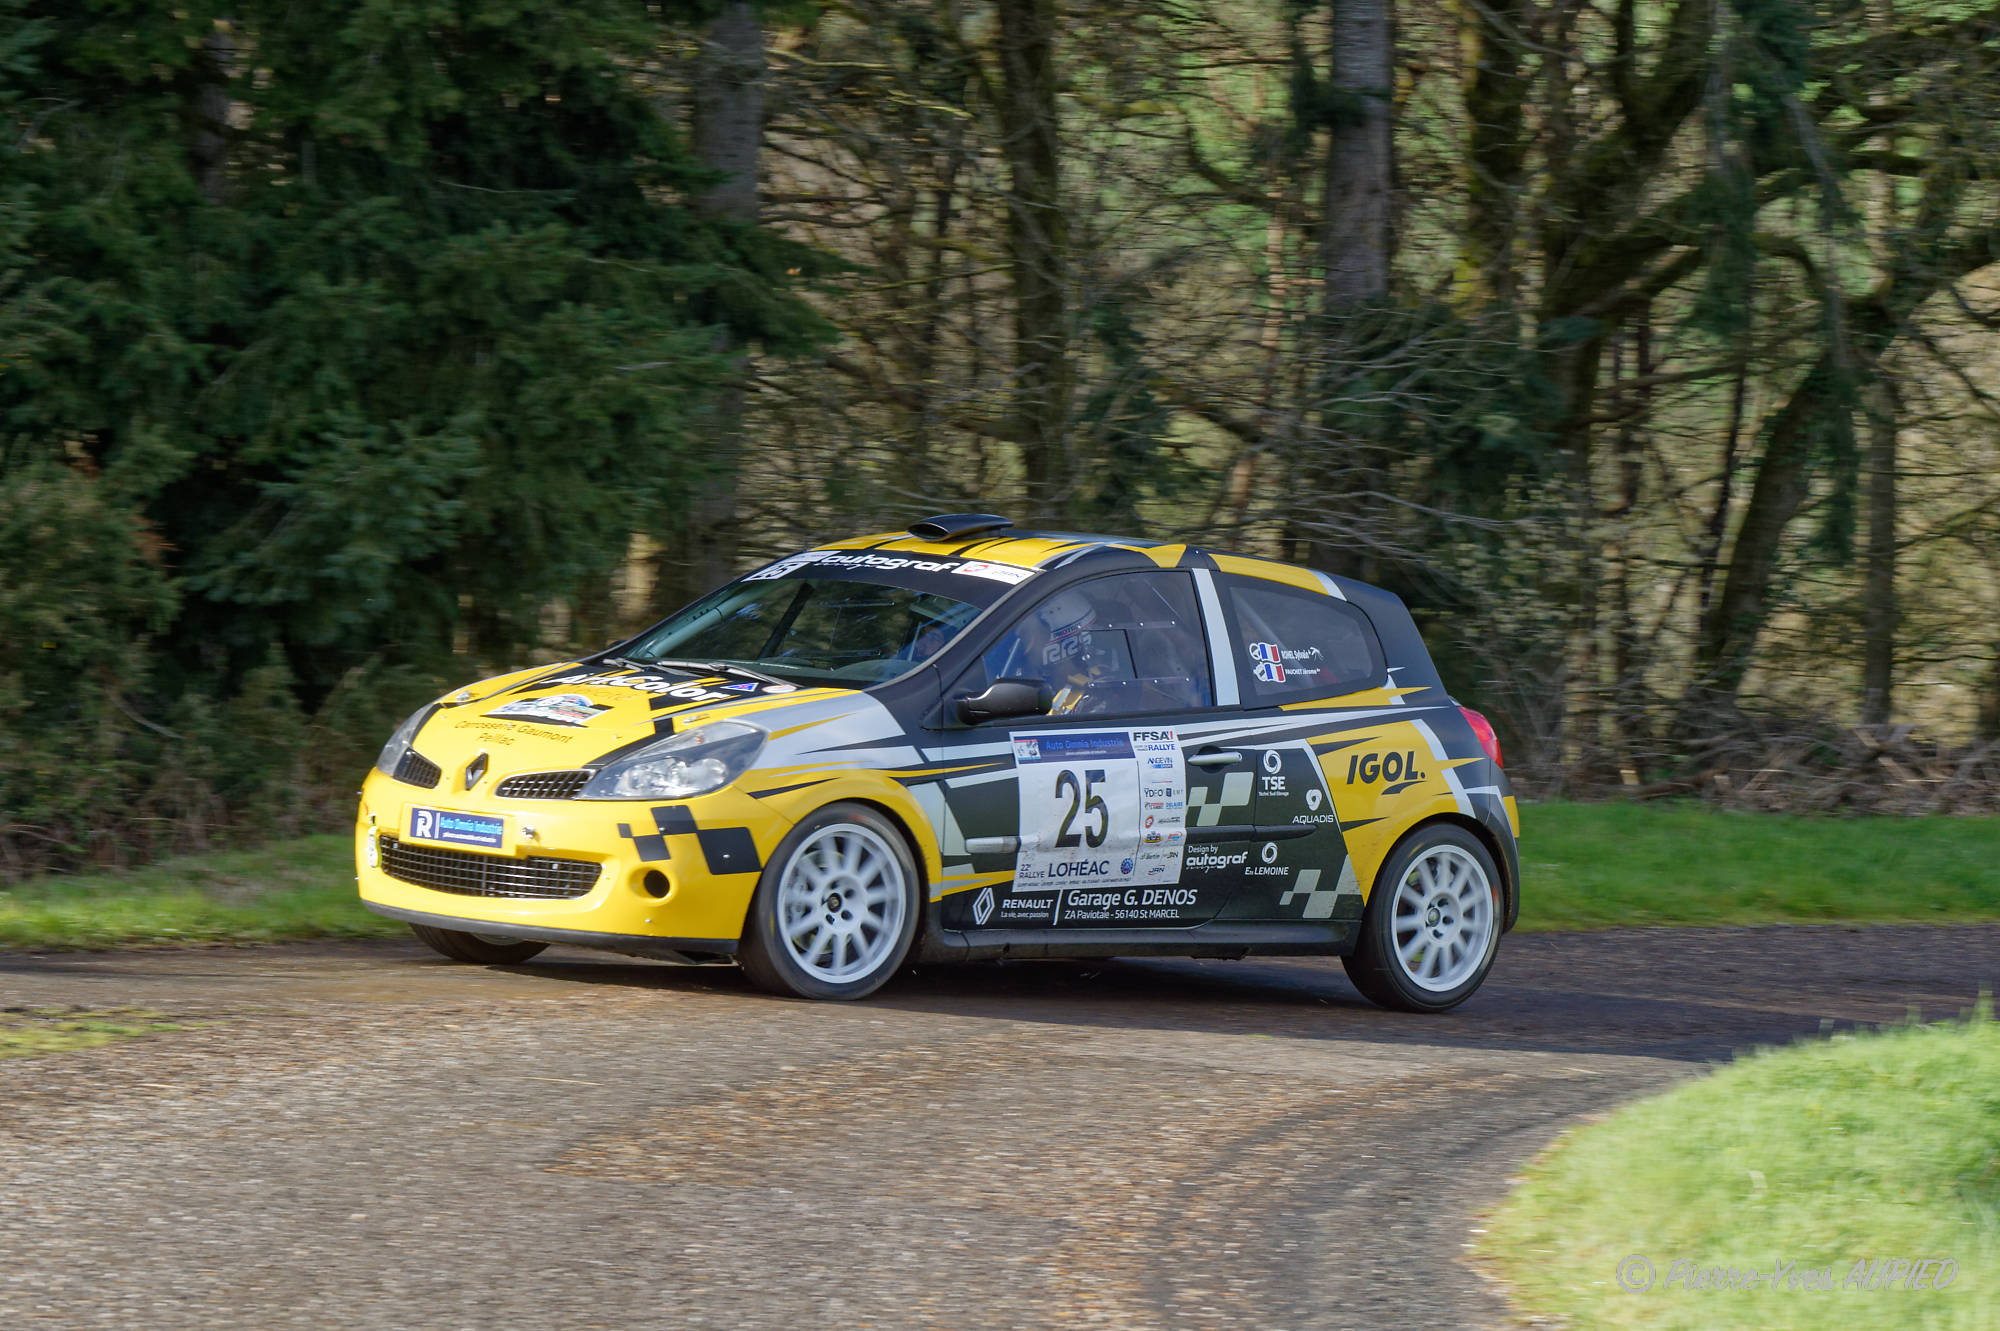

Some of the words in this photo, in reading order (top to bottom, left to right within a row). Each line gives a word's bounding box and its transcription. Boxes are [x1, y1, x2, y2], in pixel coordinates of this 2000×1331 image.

[820, 554, 961, 572] autograf
[517, 724, 574, 744] Gaumont
[1133, 731, 1170, 741] FFSA
[1148, 743, 1175, 751] RALLYE
[1261, 776, 1286, 790] TSE
[1055, 769, 1109, 849] 25
[1292, 814, 1334, 824] AQUADIS
[1188, 846, 1210, 854] Design
[1210, 844, 1219, 854] by
[1186, 851, 1248, 869] autograf
[1048, 859, 1110, 878] LOHÉAC
[1254, 866, 1289, 876] LEMOINE
[1019, 871, 1045, 879] RALLYE
[1002, 899, 1053, 909] RENAULT
[1067, 890, 1120, 910] Garage
[1123, 889, 1138, 905] G.
[1141, 888, 1198, 905] DENOS
[1064, 910, 1076, 920] ZA
[1115, 909, 1138, 919] 56140
[1139, 909, 1148, 919] St
[1149, 908, 1180, 919] MARCEL
